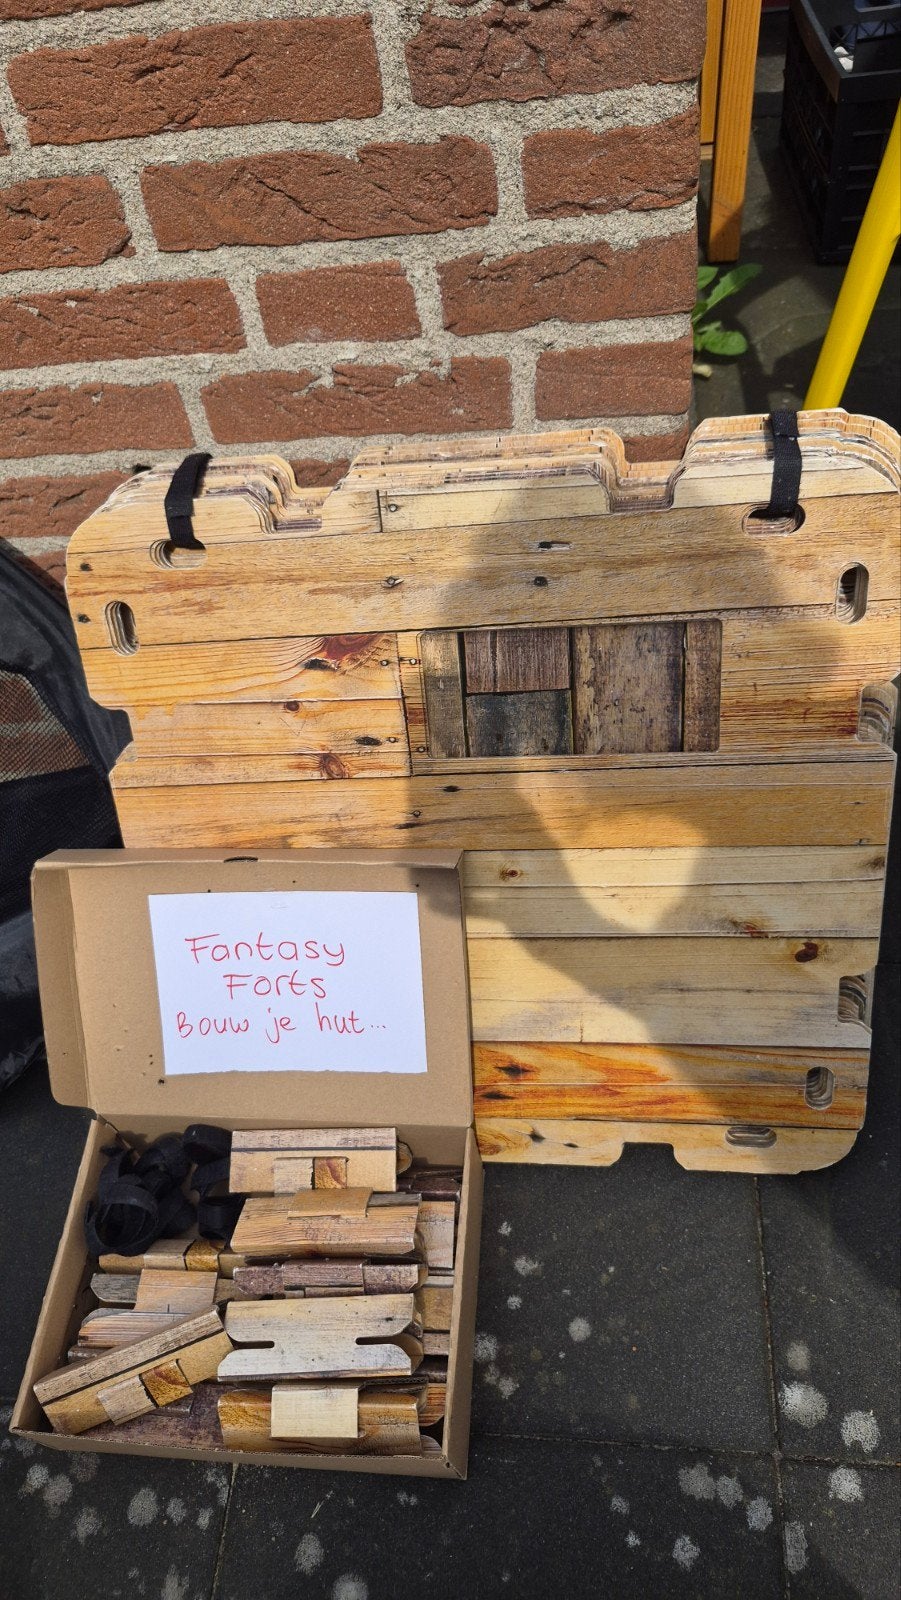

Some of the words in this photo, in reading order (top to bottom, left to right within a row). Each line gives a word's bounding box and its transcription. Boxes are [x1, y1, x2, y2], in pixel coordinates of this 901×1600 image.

[184, 931, 345, 967] Fantasy
[222, 969, 328, 1000] Forts
[176, 1011, 250, 1039] Bouw
[264, 1006, 297, 1044] je
